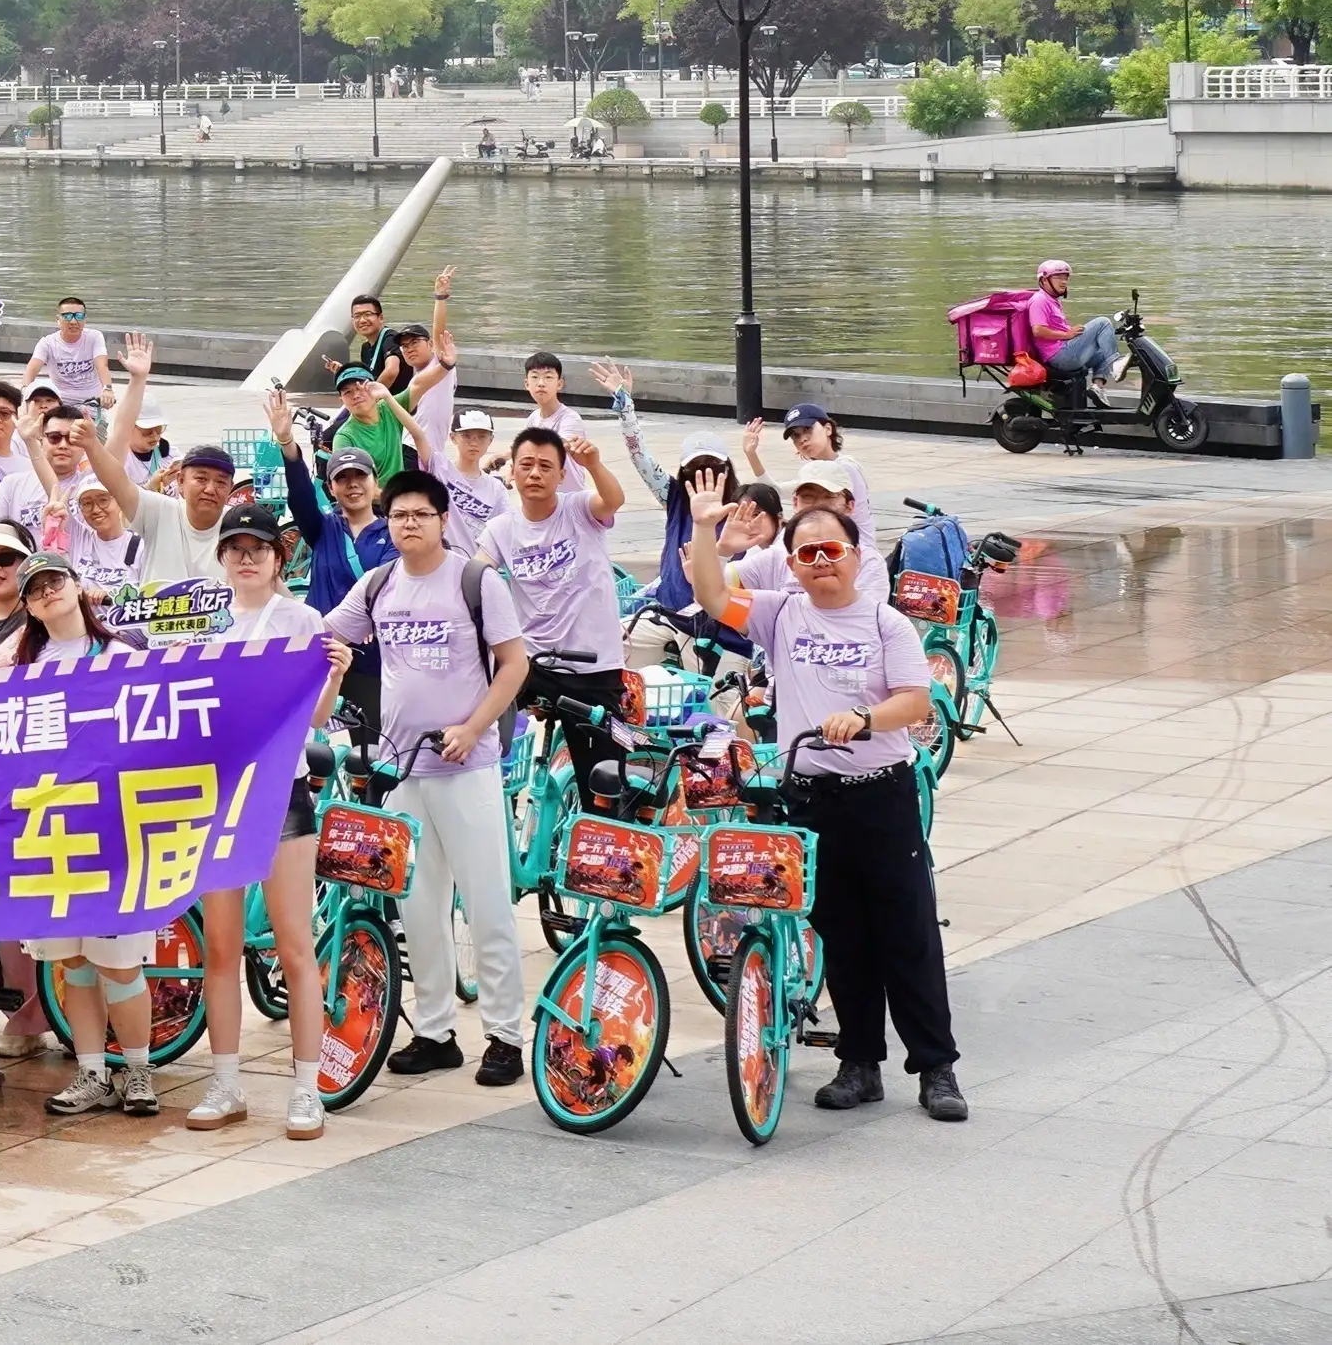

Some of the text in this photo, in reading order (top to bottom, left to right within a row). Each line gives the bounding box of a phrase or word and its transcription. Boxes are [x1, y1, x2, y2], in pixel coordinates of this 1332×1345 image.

[123, 587, 228, 621] 科学减重1亿斤
[155, 618, 206, 632] 天津代表团
[377, 621, 455, 648] 减重扛把子
[420, 659, 449, 670] 一亿斤
[791, 638, 873, 668] 减重扛把子
